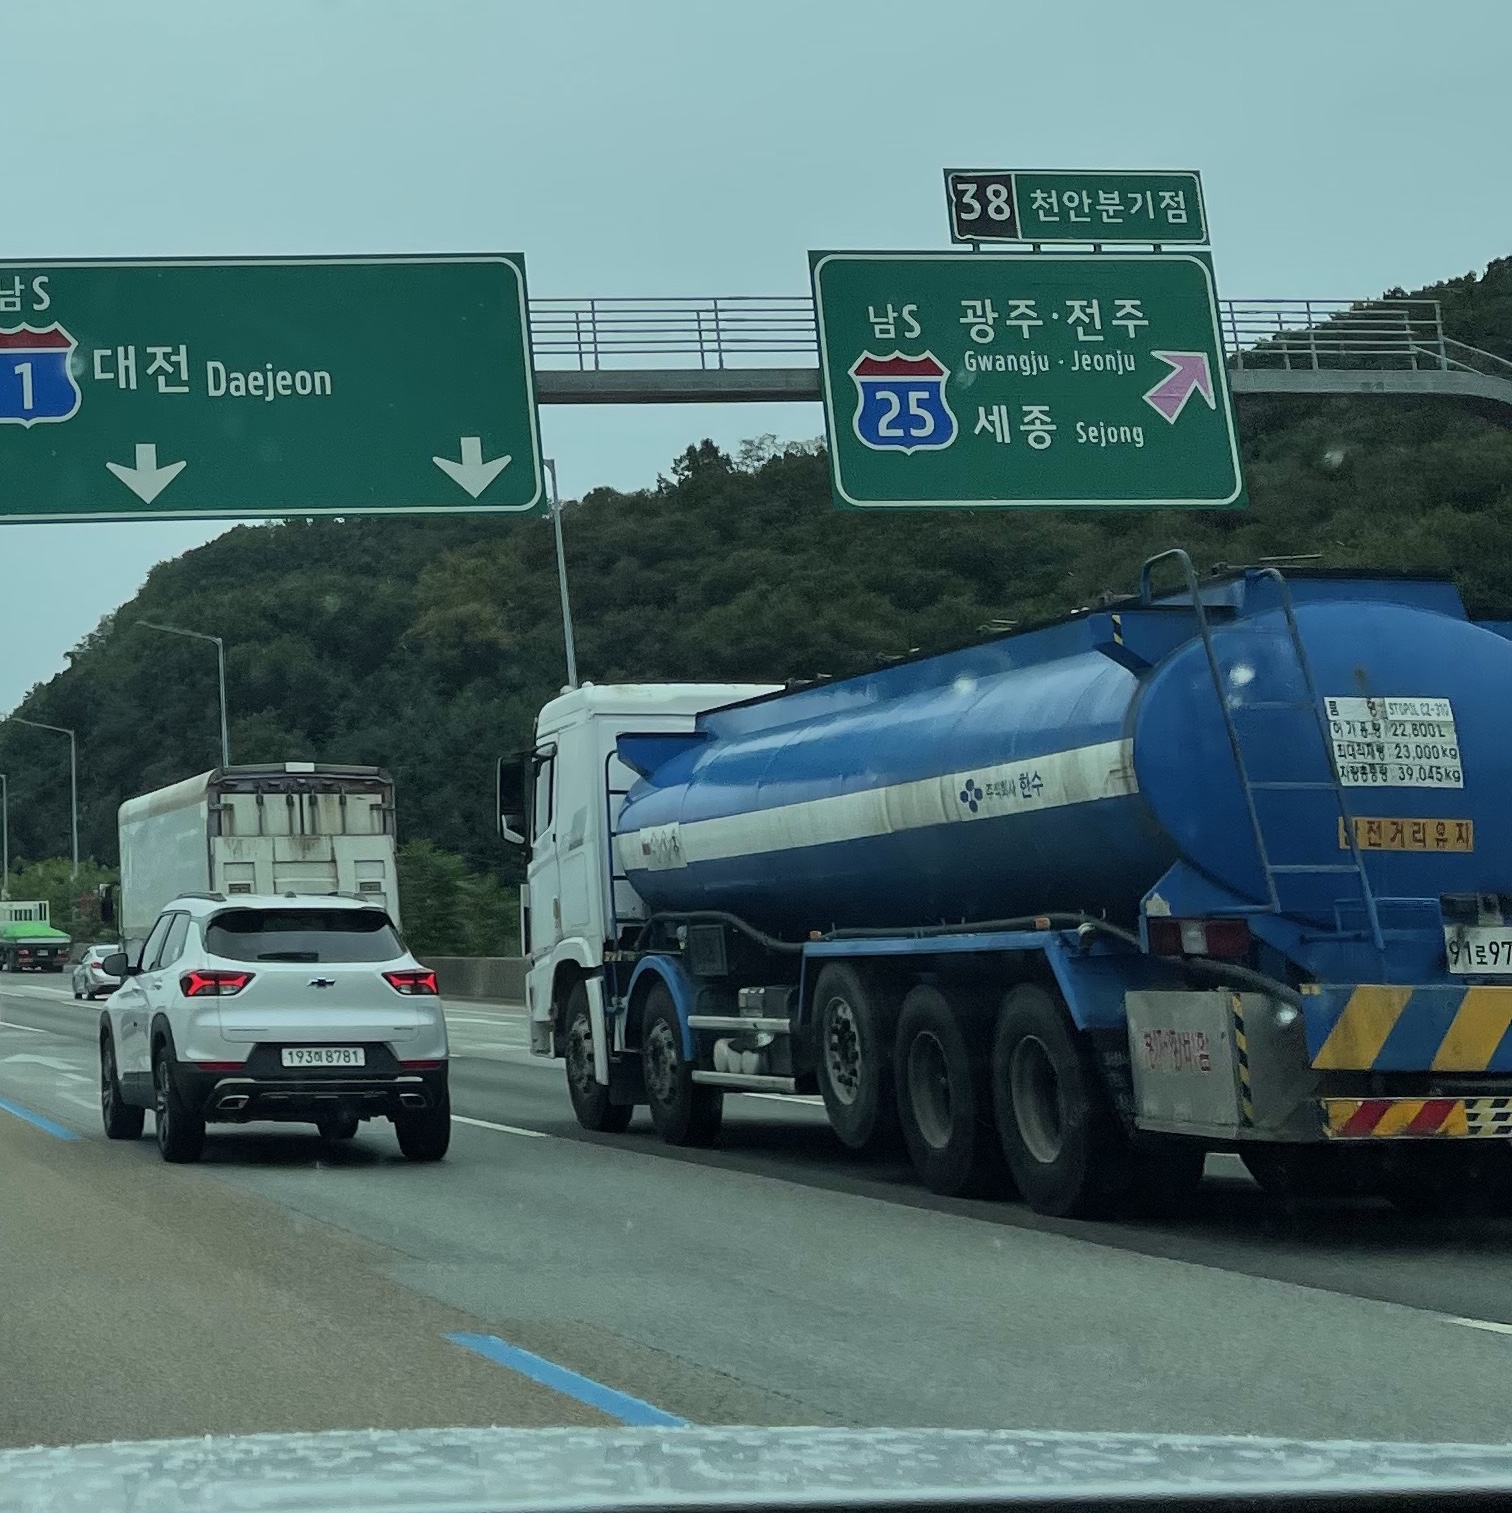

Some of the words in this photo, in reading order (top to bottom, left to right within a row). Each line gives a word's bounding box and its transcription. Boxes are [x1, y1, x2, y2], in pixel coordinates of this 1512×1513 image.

[955, 182, 1012, 221] 38
[1029, 188, 1188, 225] 천안분기점
[92, 343, 190, 397] 대전
[207, 360, 333, 404] Daejeon
[963, 350, 1050, 376] Gwangju
[1071, 350, 1136, 374] Jeonju
[14, 361, 34, 411] 1
[874, 390, 936, 438] 25
[973, 404, 1058, 451] 세종
[1076, 421, 1144, 449] Sejong
[1018, 771, 1044, 799] 한수
